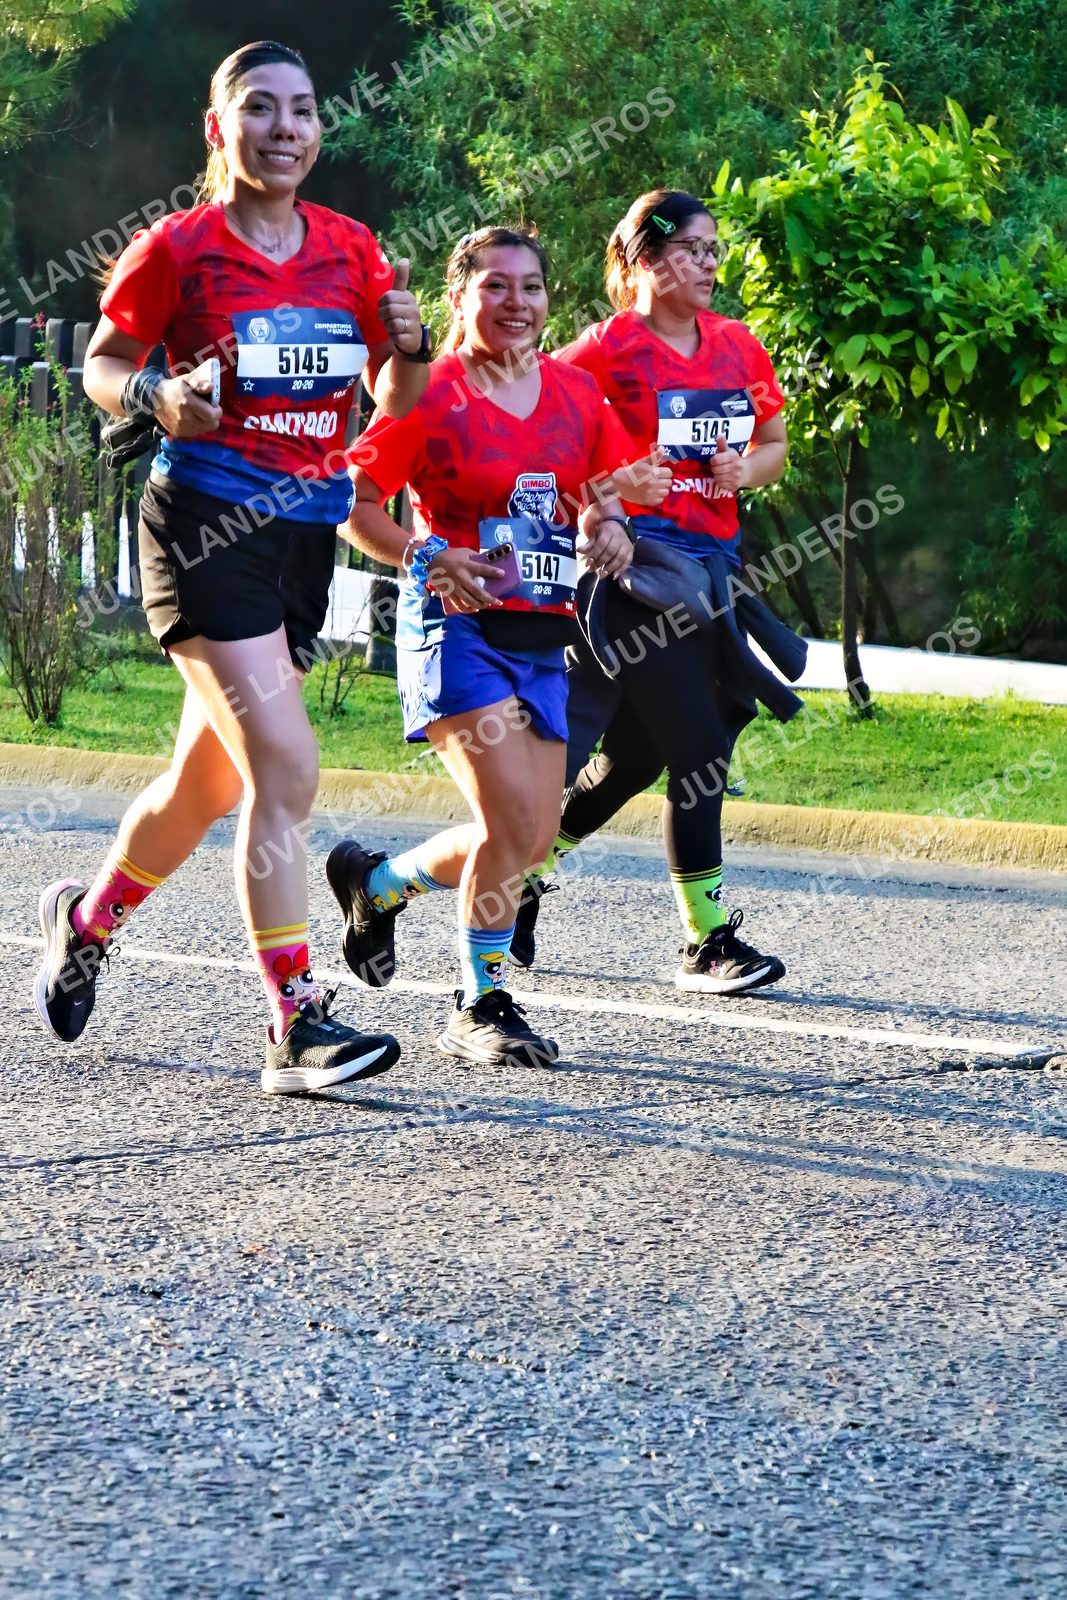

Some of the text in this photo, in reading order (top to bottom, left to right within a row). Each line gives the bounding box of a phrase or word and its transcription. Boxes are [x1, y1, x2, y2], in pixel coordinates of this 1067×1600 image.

[278, 346, 329, 374] 5145
[691, 419, 731, 443] 5146
[521, 480, 550, 488] BIMBO
[522, 553, 560, 582] 5147
